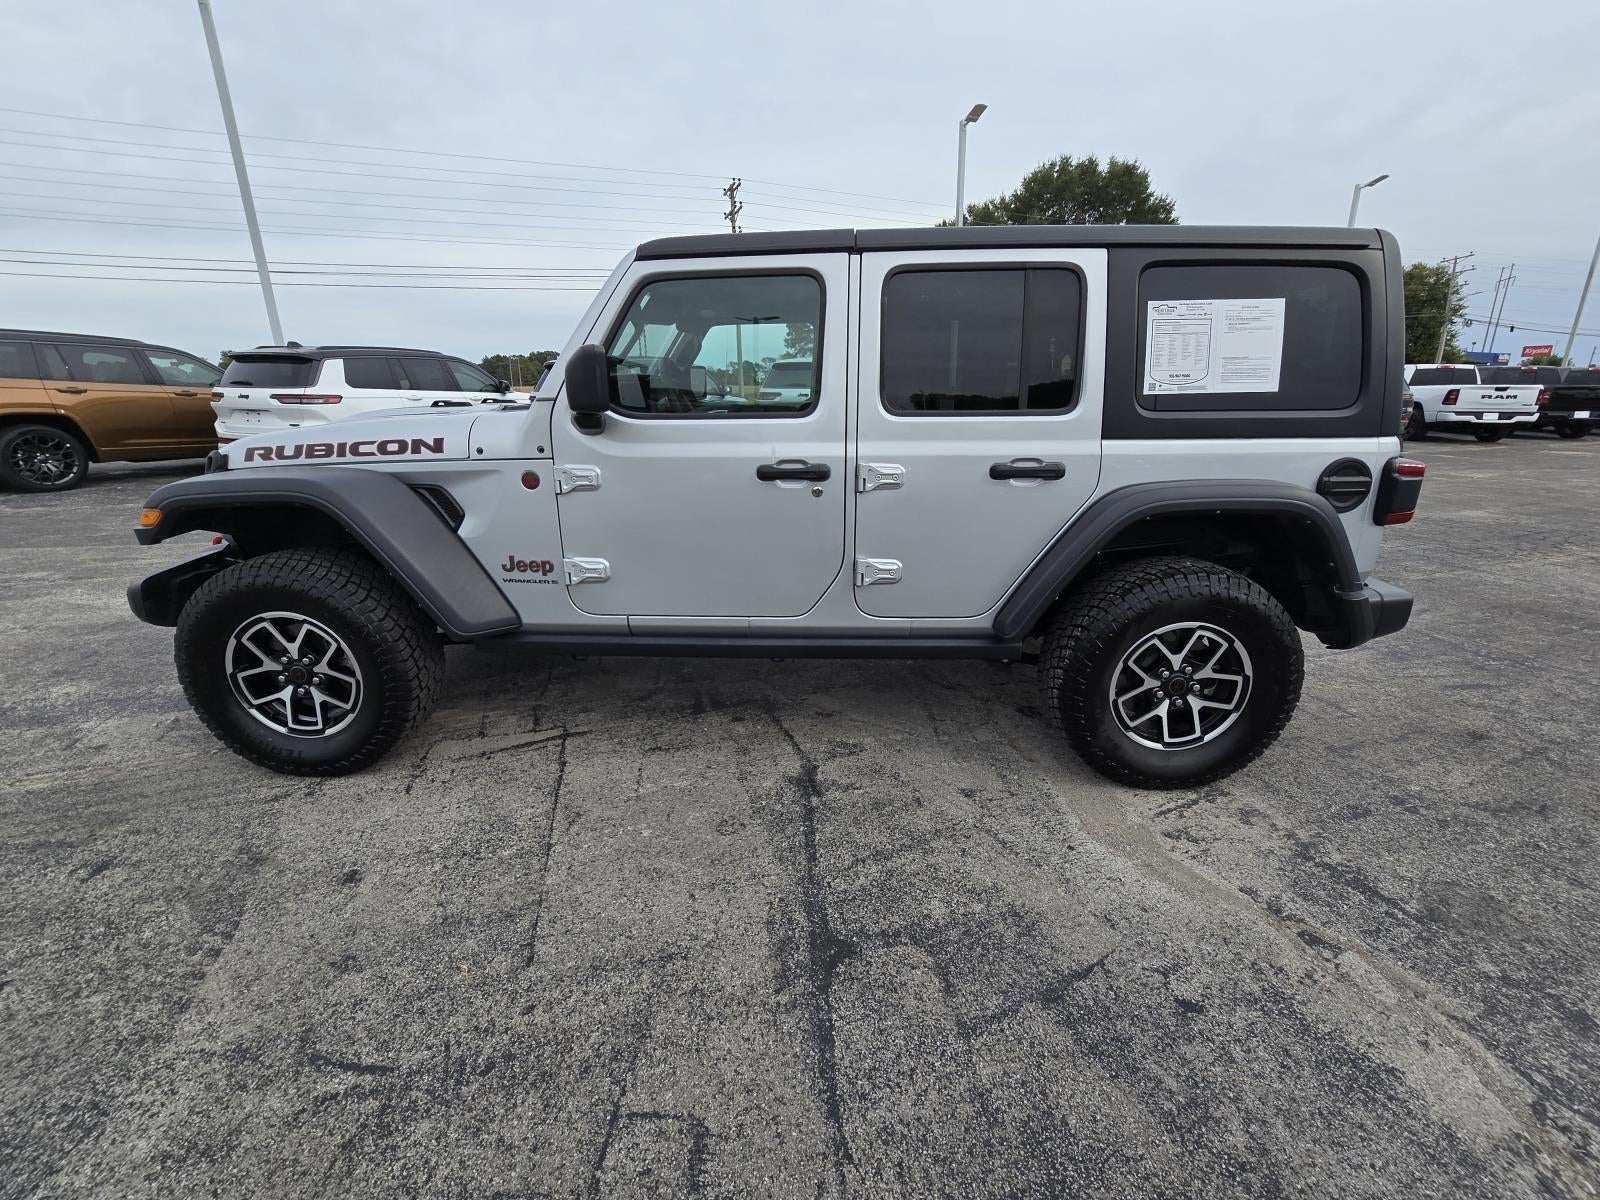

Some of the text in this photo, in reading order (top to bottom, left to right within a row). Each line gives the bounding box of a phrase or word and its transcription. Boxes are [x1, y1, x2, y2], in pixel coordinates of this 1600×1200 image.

[1524, 347, 1551, 355] Krystal
[244, 437, 445, 462] RUBICON
[502, 555, 554, 576] Jeep
